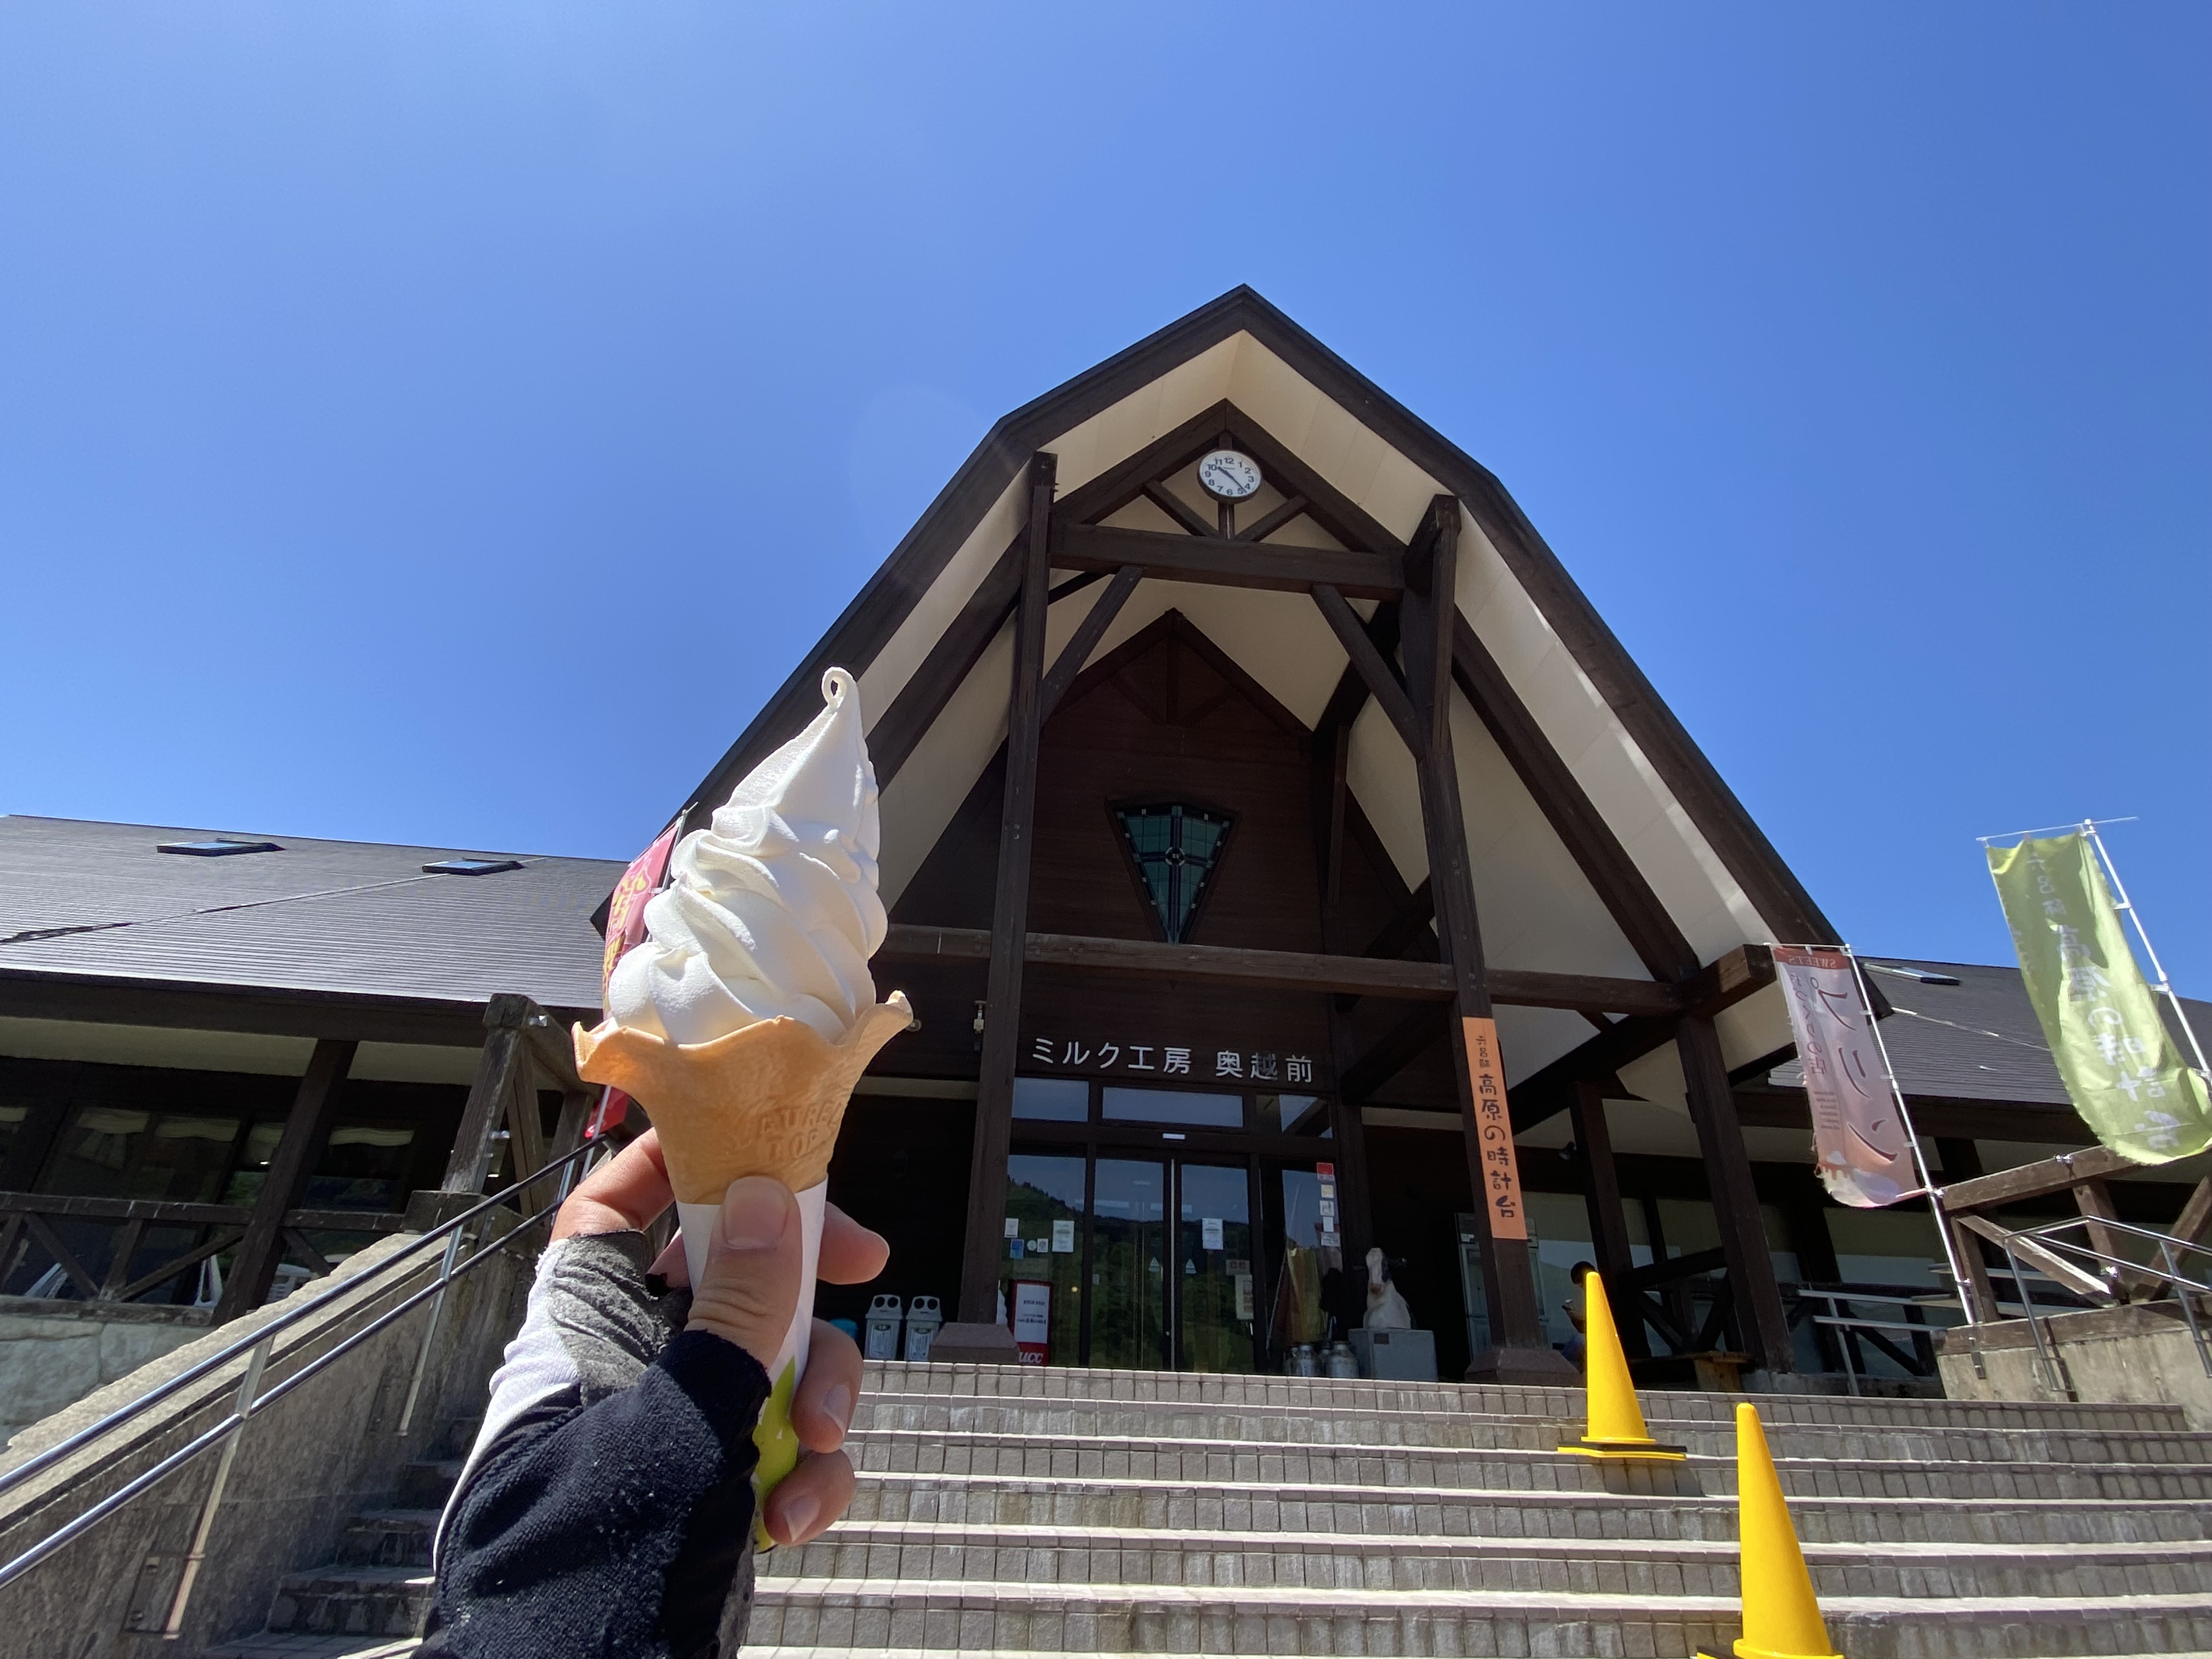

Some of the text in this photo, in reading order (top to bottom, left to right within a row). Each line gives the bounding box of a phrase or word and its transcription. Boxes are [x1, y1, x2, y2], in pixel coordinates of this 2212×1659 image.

[1032, 1037, 1312, 1082] ミルク工房 奥越前
[1019, 1352, 1043, 1363] UCC
